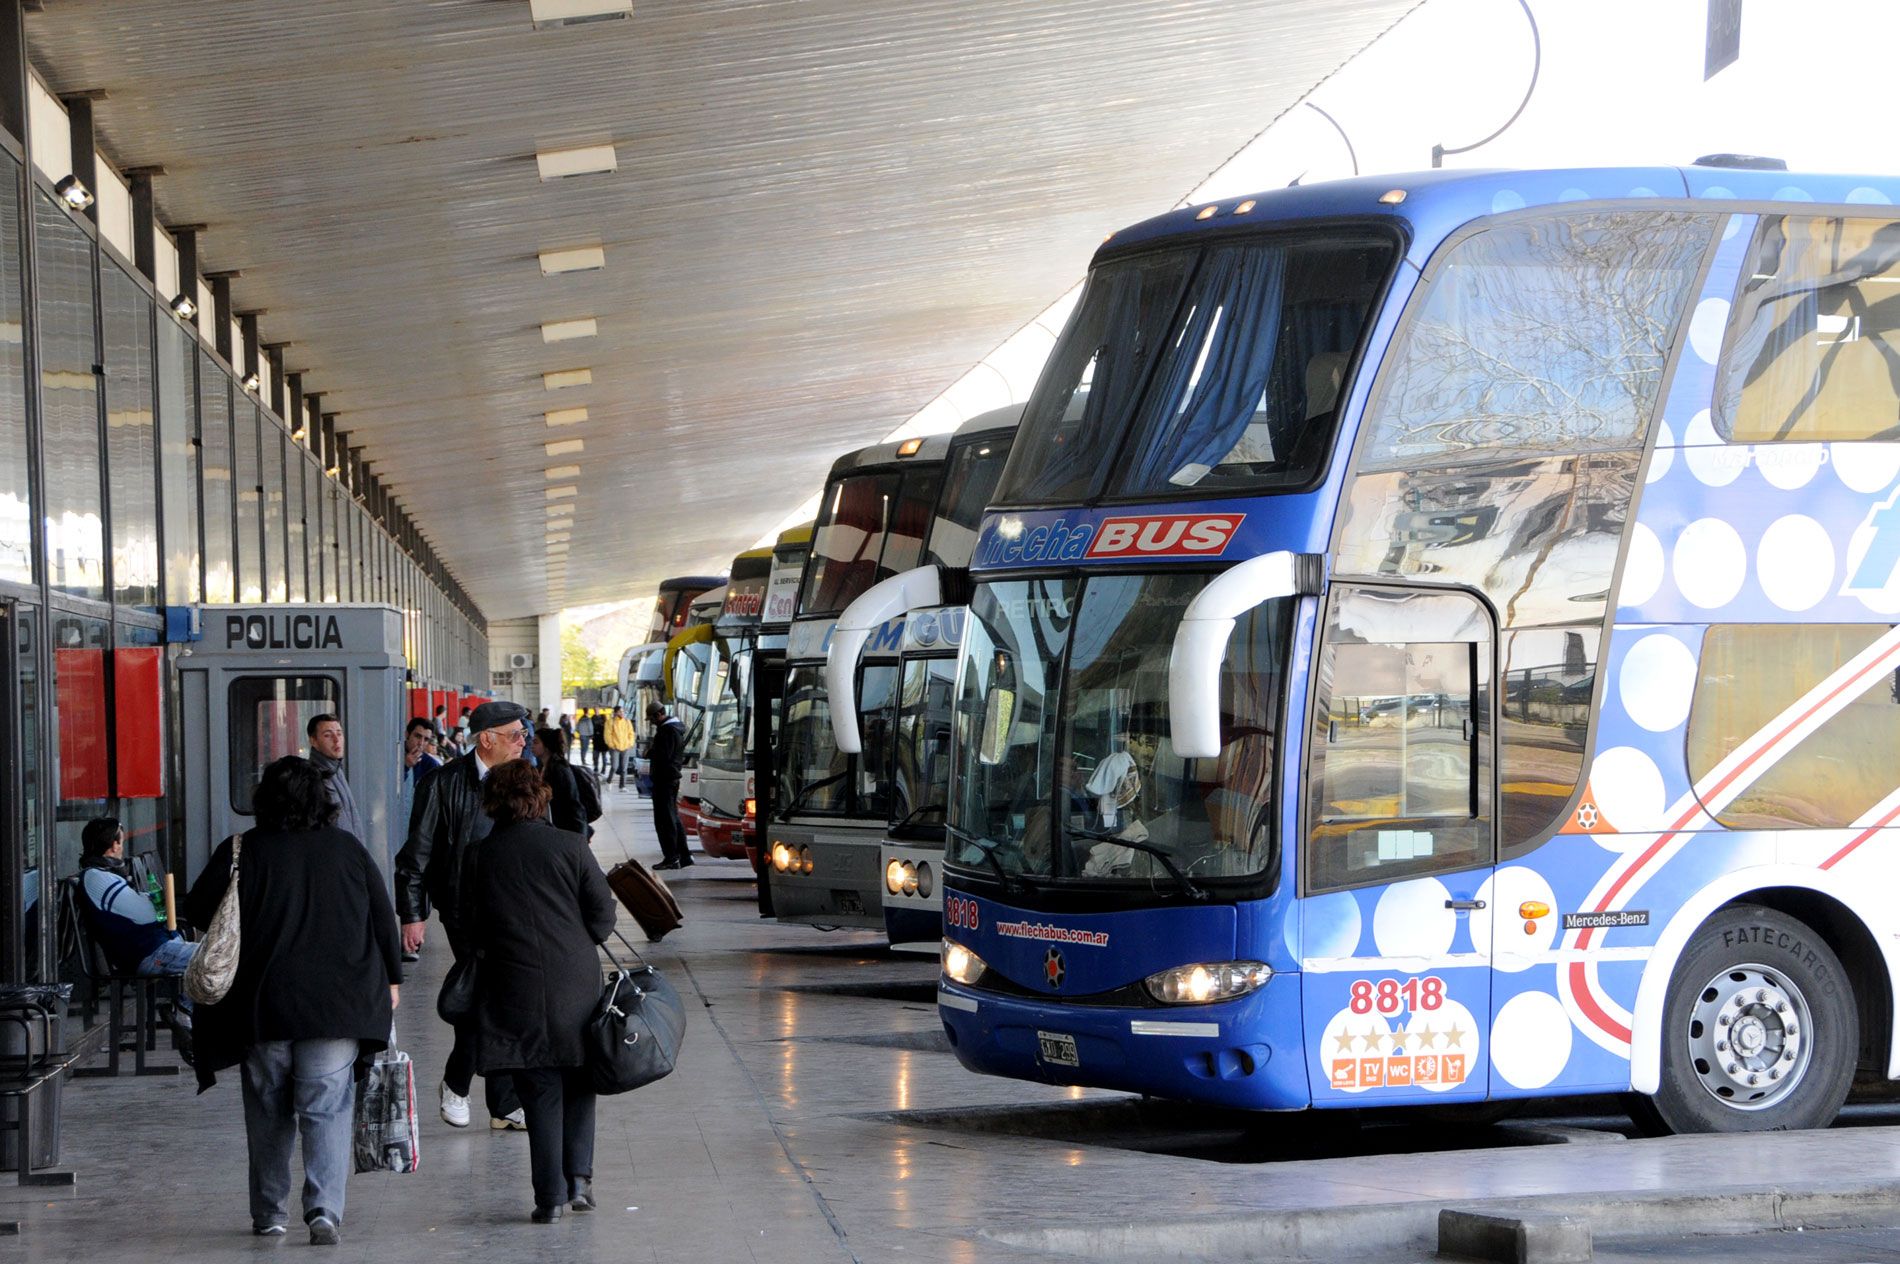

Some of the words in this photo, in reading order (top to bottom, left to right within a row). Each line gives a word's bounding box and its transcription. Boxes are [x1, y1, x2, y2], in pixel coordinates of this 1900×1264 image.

[1093, 519, 1233, 554] BUS
[226, 615, 343, 649] POLICIA
[946, 895, 979, 930] 8818
[1565, 912, 1647, 928] Mercedes-Benz
[996, 921, 1109, 947] www.flechabus.com.ar
[1723, 926, 1837, 995] FATECARGO
[1350, 977, 1443, 1015] 8818
[1364, 1063, 1379, 1075] TV
[1389, 1065, 1409, 1077] WC
